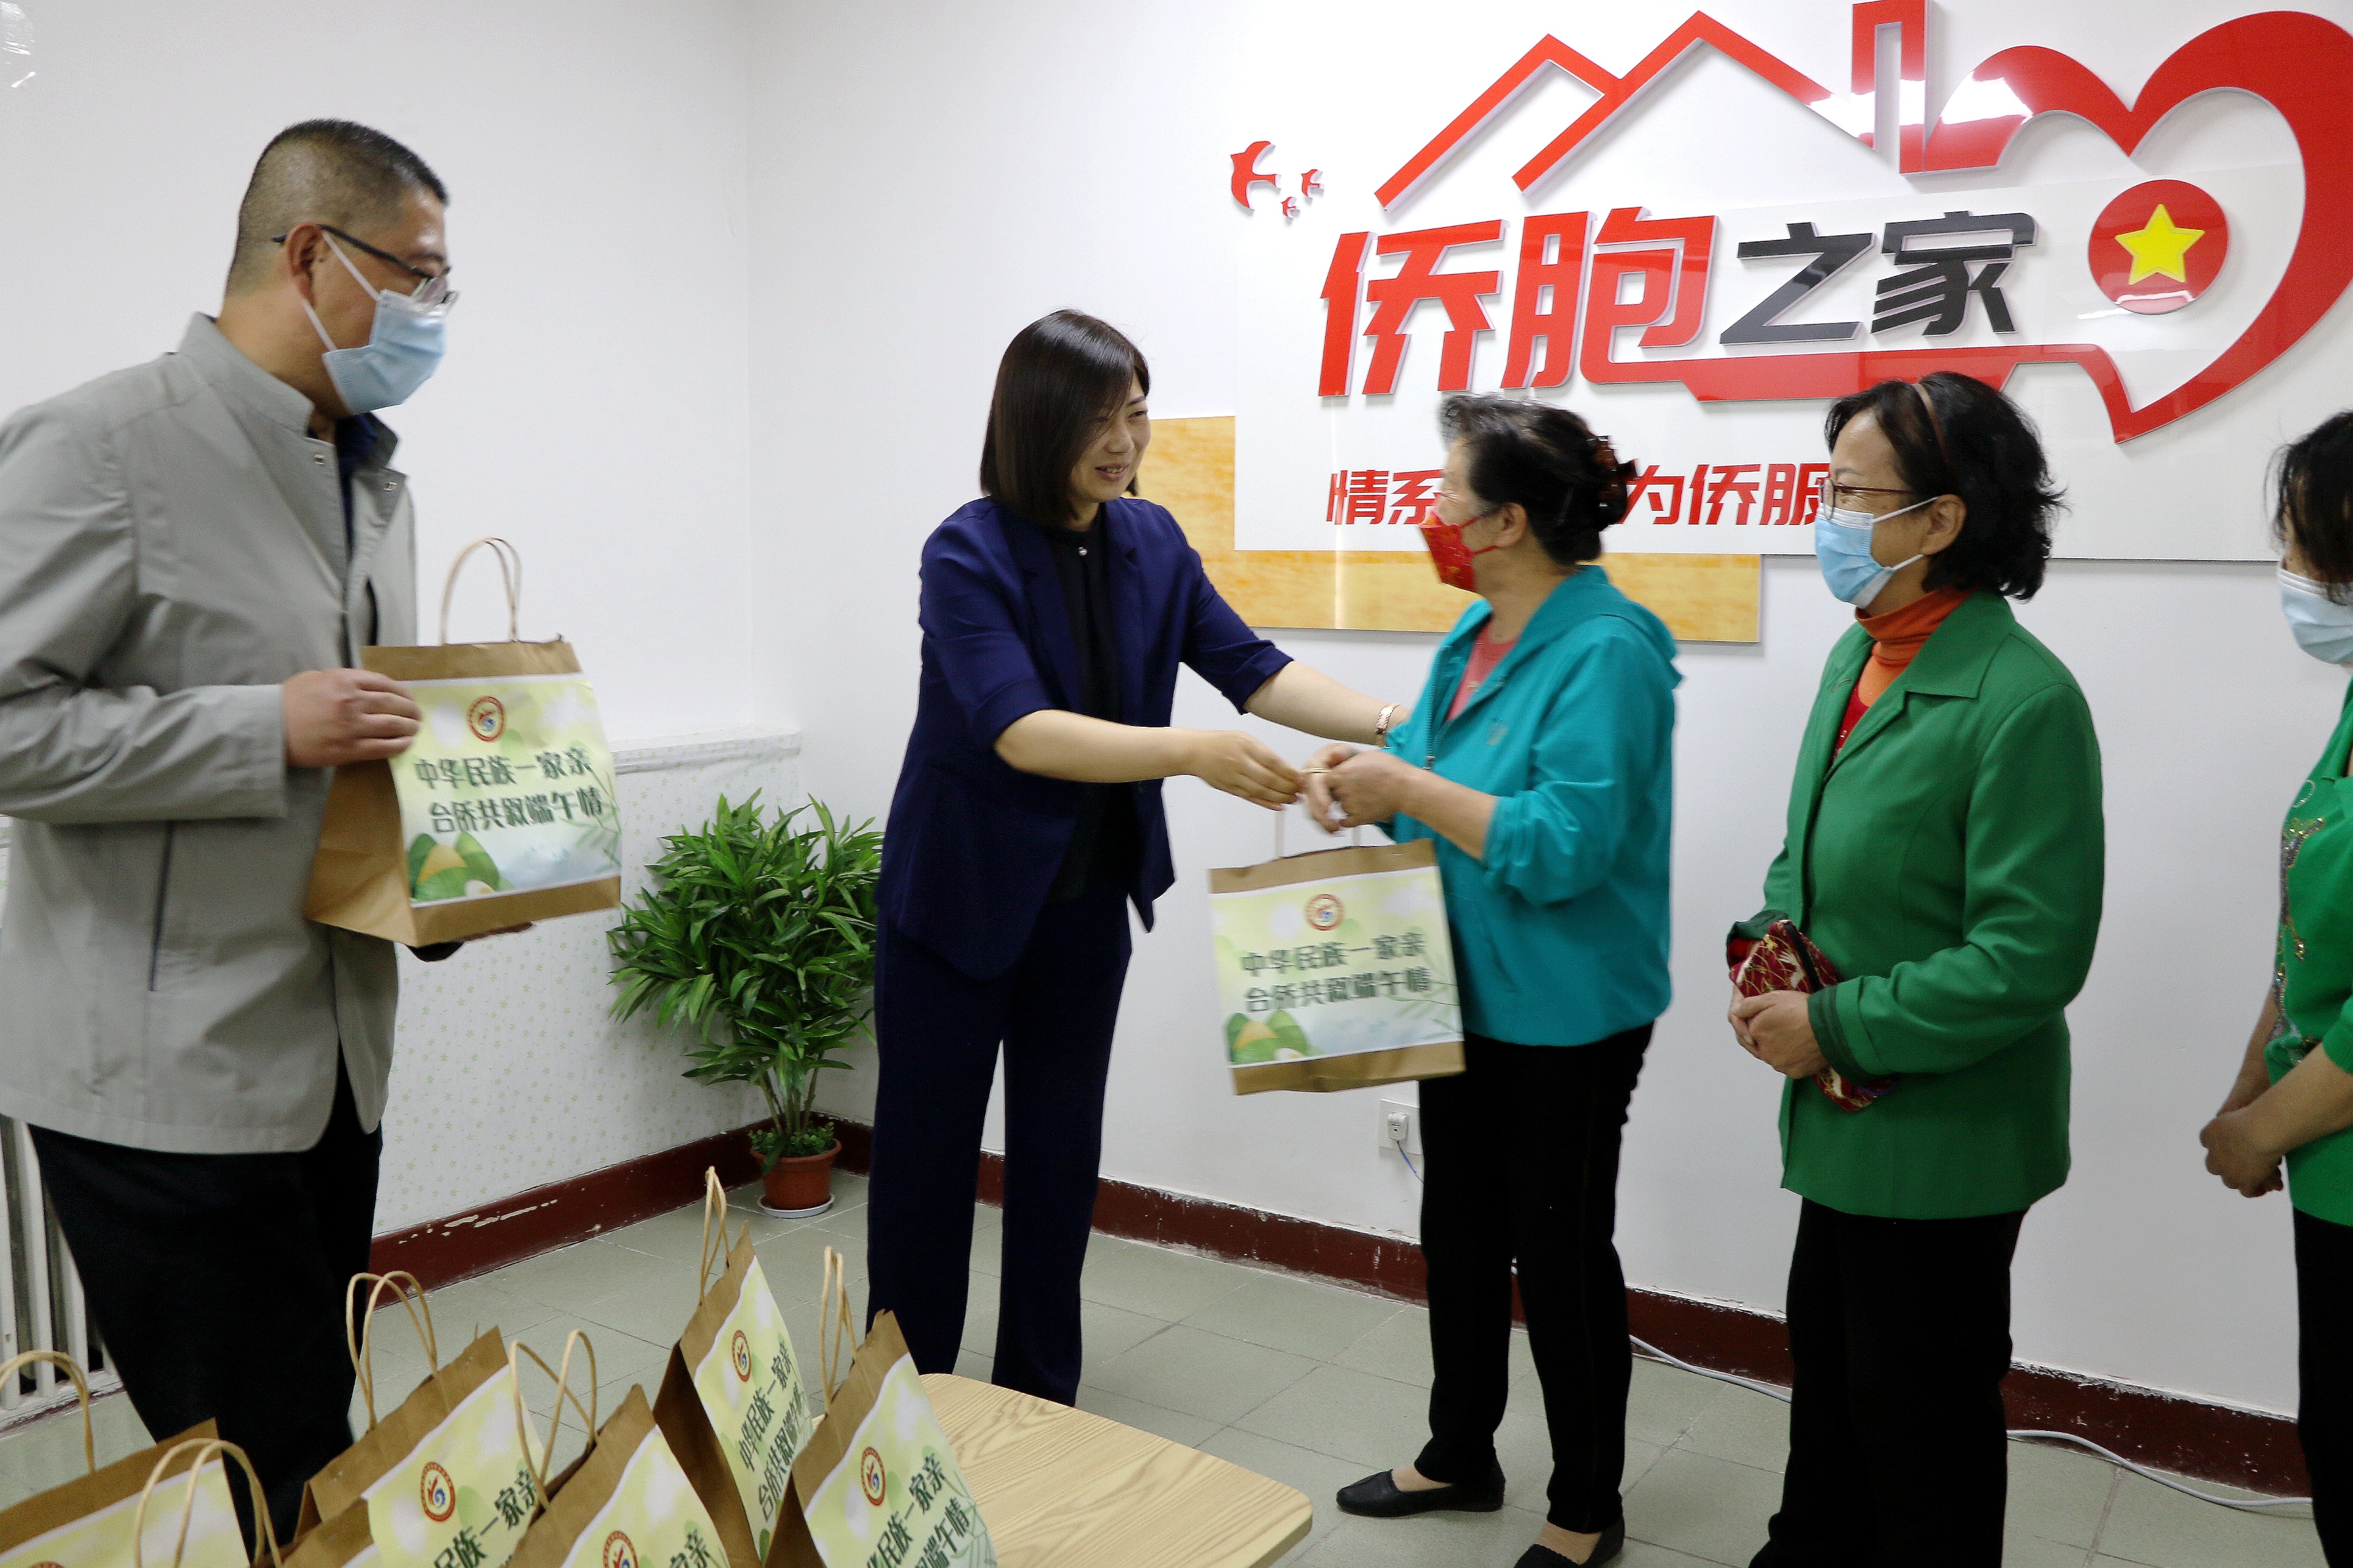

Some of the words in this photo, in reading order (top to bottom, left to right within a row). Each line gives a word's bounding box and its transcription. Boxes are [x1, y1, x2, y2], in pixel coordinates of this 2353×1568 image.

[1319, 206, 2038, 397] 侨胞之家
[1326, 469, 1444, 525] 情系
[1609, 463, 1831, 526] 为侨服
[414, 747, 593, 790] 中华民族一家亲
[430, 786, 603, 834] 台侨共叙端午情
[739, 1341, 791, 1472] 中华民族一家亲
[916, 1497, 970, 1568] 端午情
